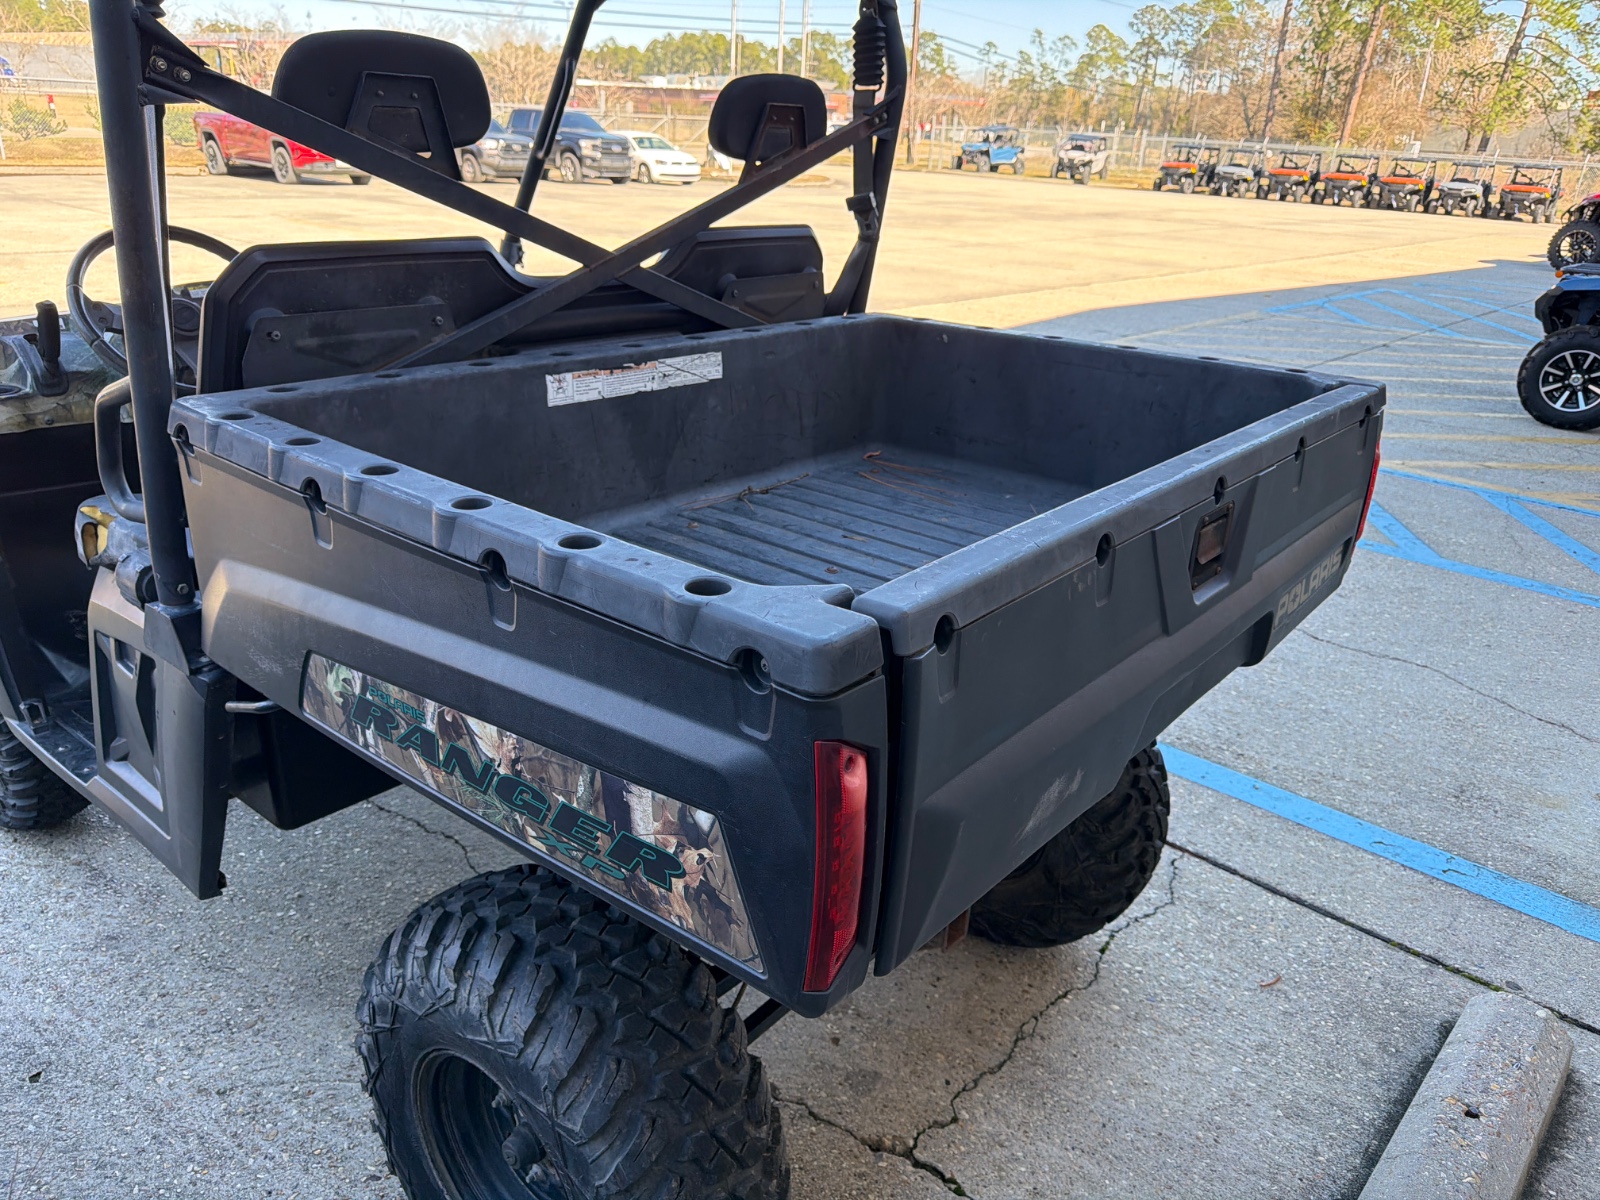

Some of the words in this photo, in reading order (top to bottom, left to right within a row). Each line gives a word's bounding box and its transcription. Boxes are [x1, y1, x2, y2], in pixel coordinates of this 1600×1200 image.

[1275, 546, 1343, 627] POLARIS
[368, 685, 426, 724] POLARIS
[351, 695, 686, 890] RANGER
[537, 828, 627, 880] XP
